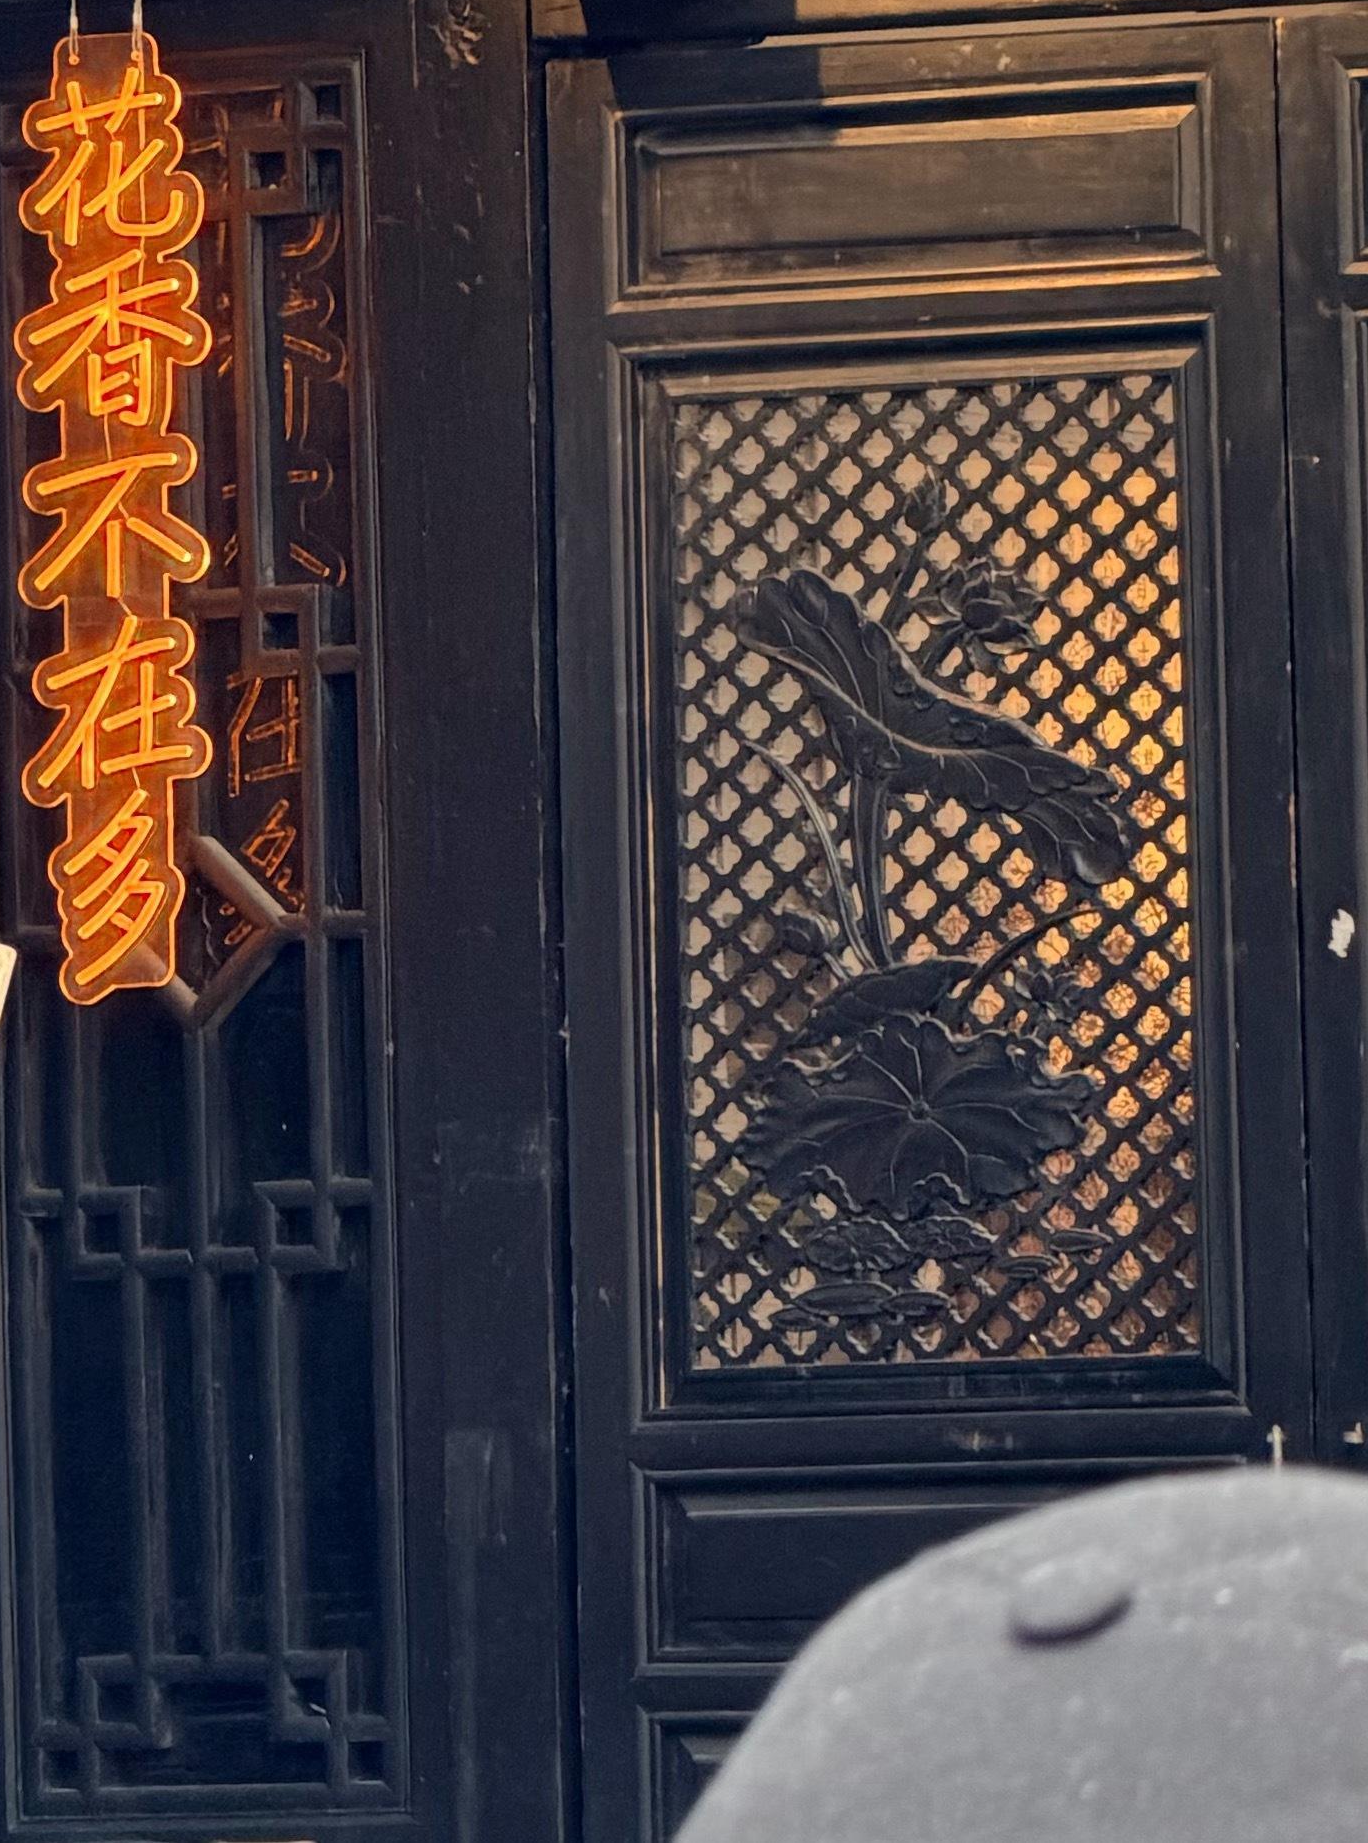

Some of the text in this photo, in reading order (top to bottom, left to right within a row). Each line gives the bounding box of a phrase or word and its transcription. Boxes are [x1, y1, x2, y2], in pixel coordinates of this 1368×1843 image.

[27, 79, 194, 986] 花香不在多
